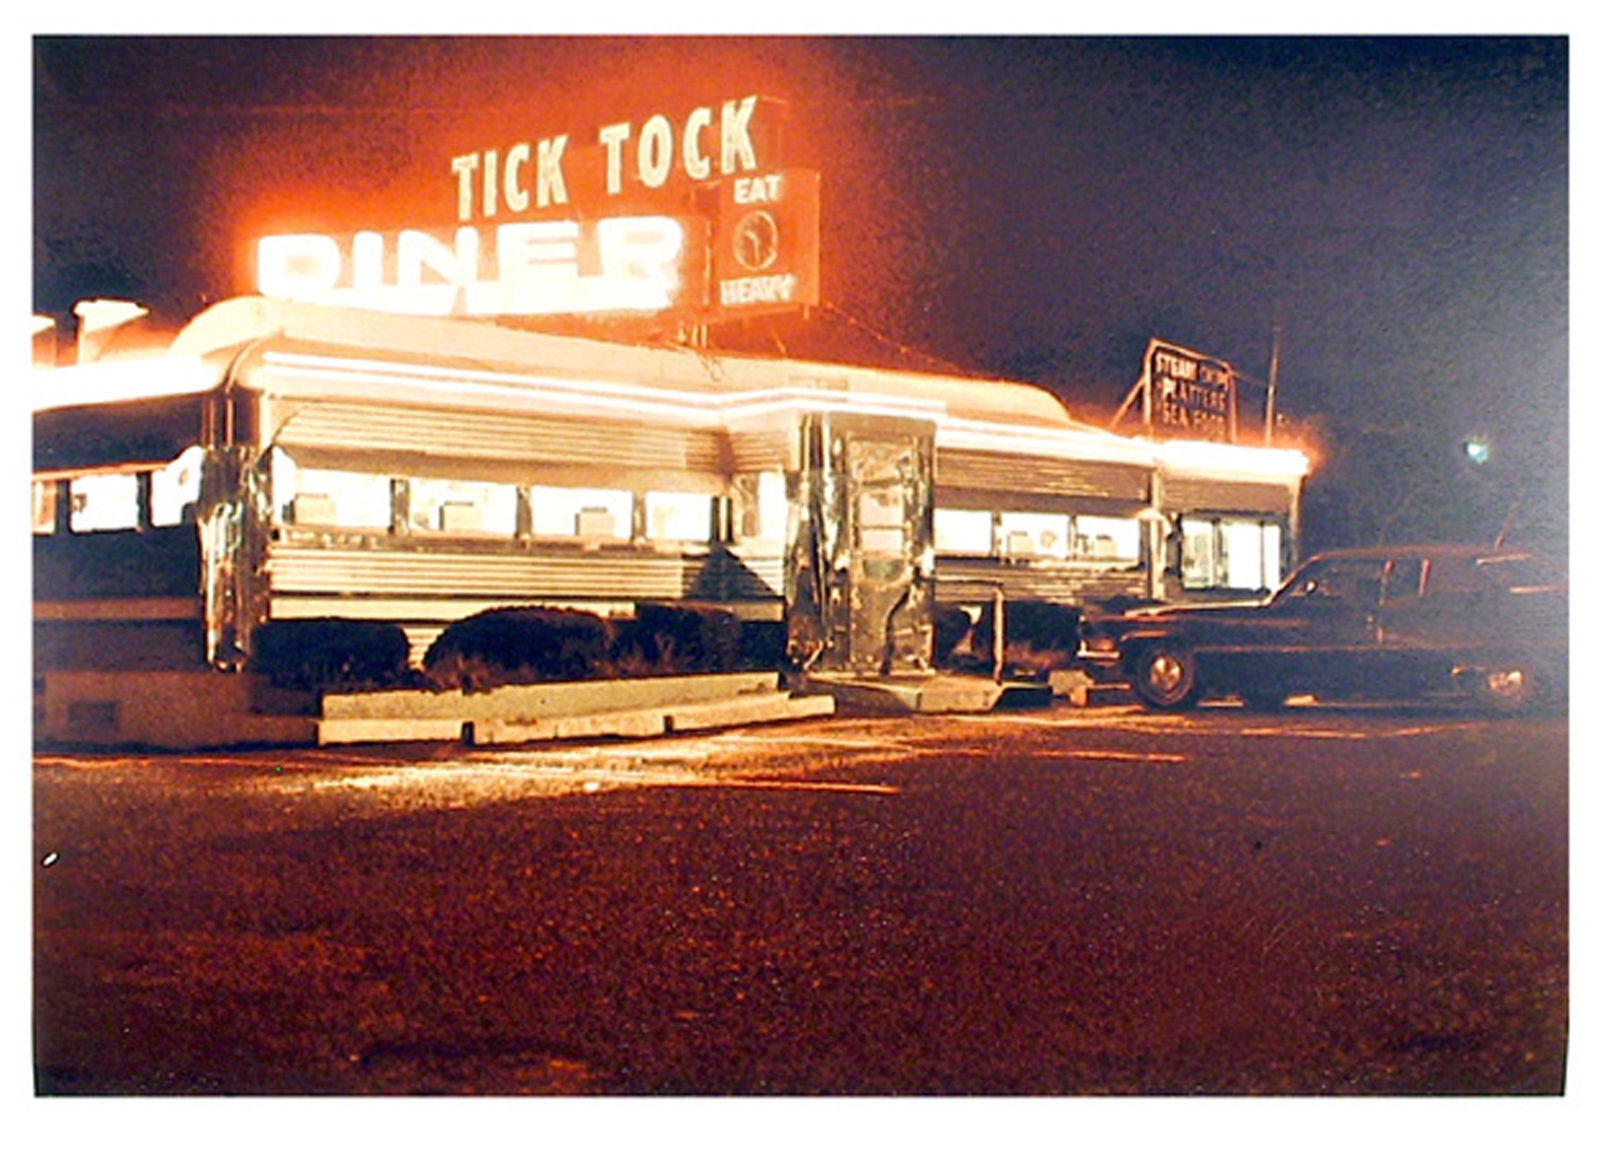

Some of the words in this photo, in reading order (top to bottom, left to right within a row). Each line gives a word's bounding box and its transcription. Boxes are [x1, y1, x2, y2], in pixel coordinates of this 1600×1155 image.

[452, 134, 569, 221] TICK
[599, 95, 757, 195] TOCK
[734, 173, 783, 204] EAT
[257, 215, 684, 302] DINER
[720, 273, 796, 306] HEAVY
[1162, 401, 1190, 428] SEA
